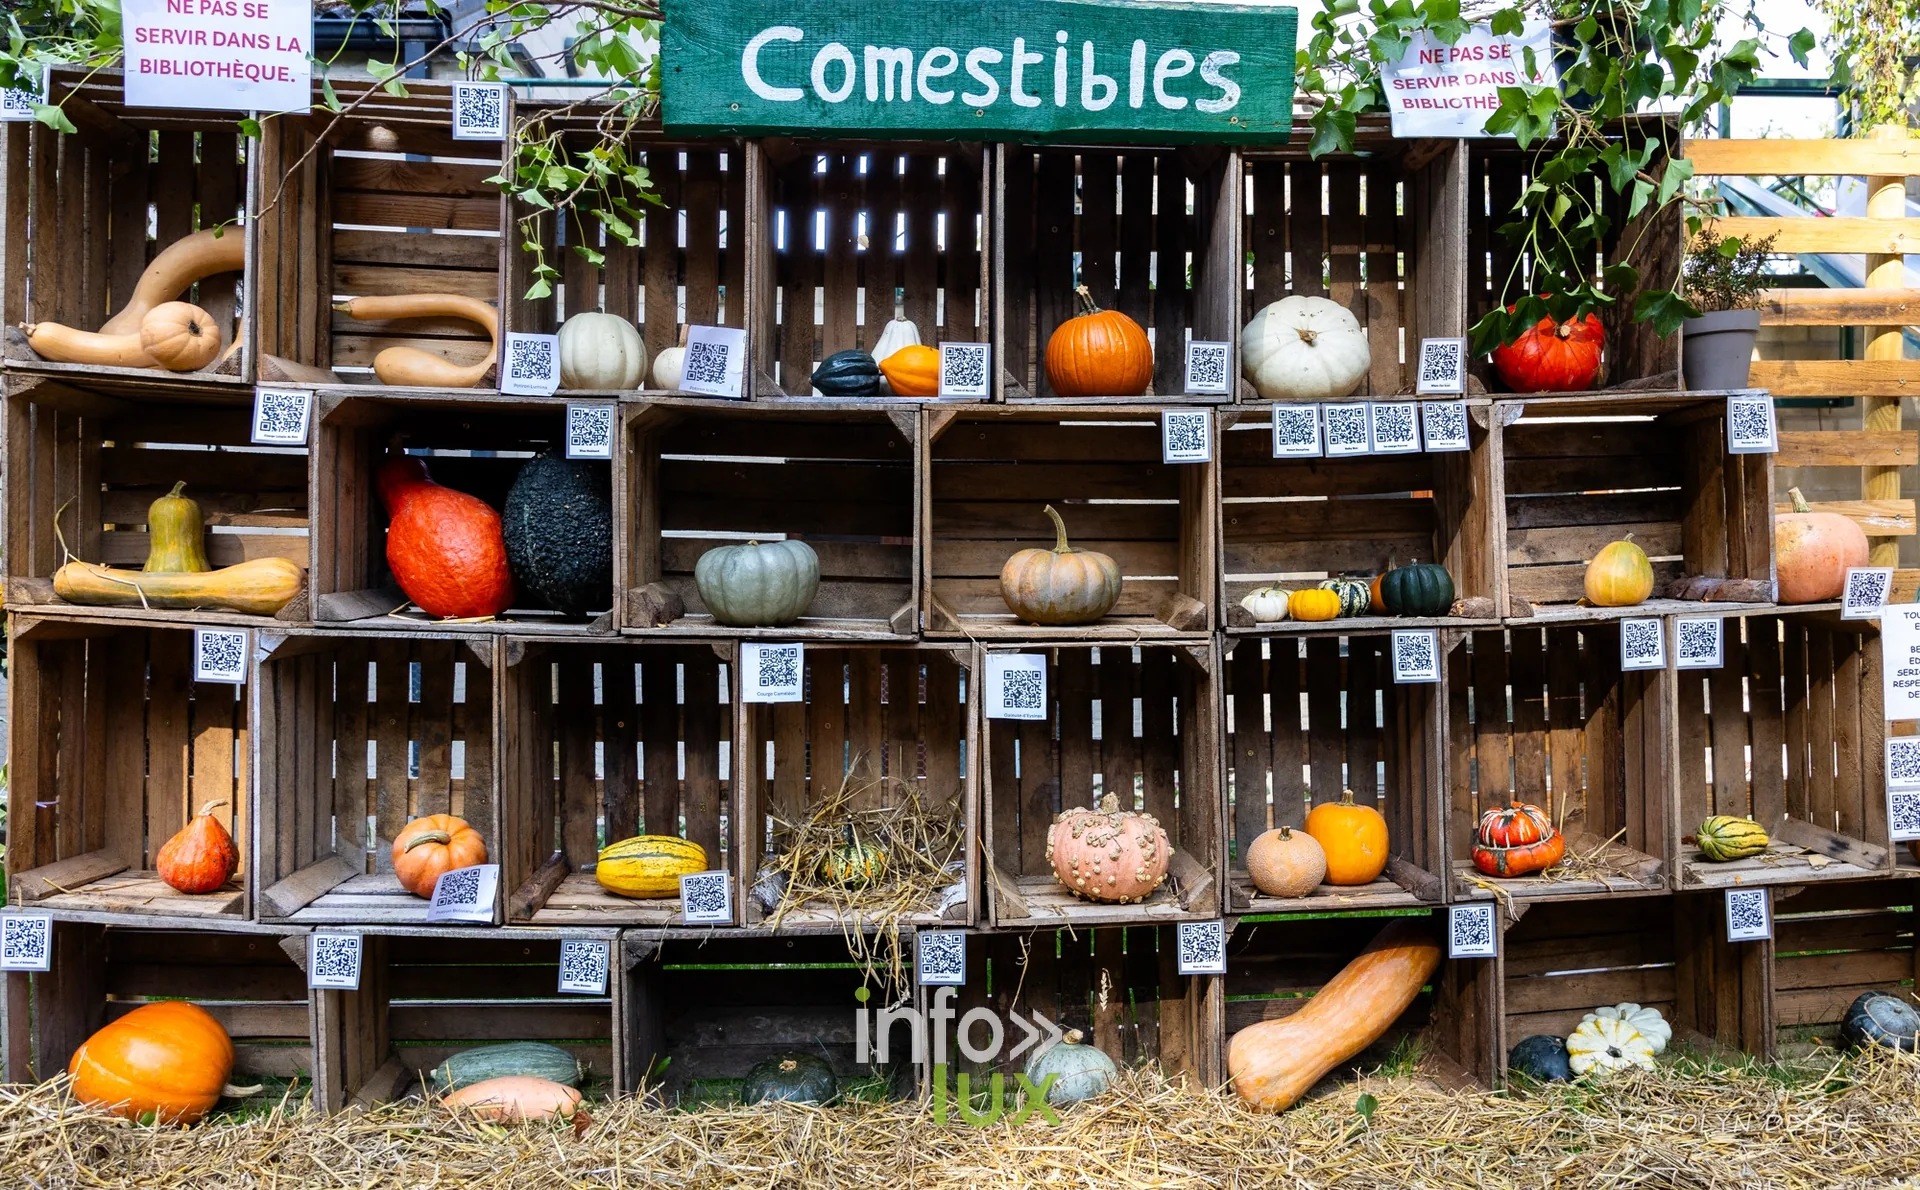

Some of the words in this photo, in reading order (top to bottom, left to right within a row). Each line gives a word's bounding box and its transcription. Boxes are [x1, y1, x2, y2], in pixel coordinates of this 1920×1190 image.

[167, 0, 194, 14] NE
[200, 0, 238, 17] PAS
[243, 3, 269, 19] SE
[135, 27, 207, 46] SERVIR
[213, 31, 270, 50] DANS
[276, 36, 302, 53] LA
[1420, 49, 1443, 64] NE
[1449, 46, 1484, 62] PAS
[1488, 44, 1511, 59] SE
[140, 58, 296, 83] BIBLIOTHÈQUE.
[742, 25, 1241, 112] Comestibles
[1393, 75, 1459, 91] SERVIR
[1464, 71, 1515, 86] DANS
[1521, 70, 1544, 84] A
[1897, 669, 1920, 677] SERI
